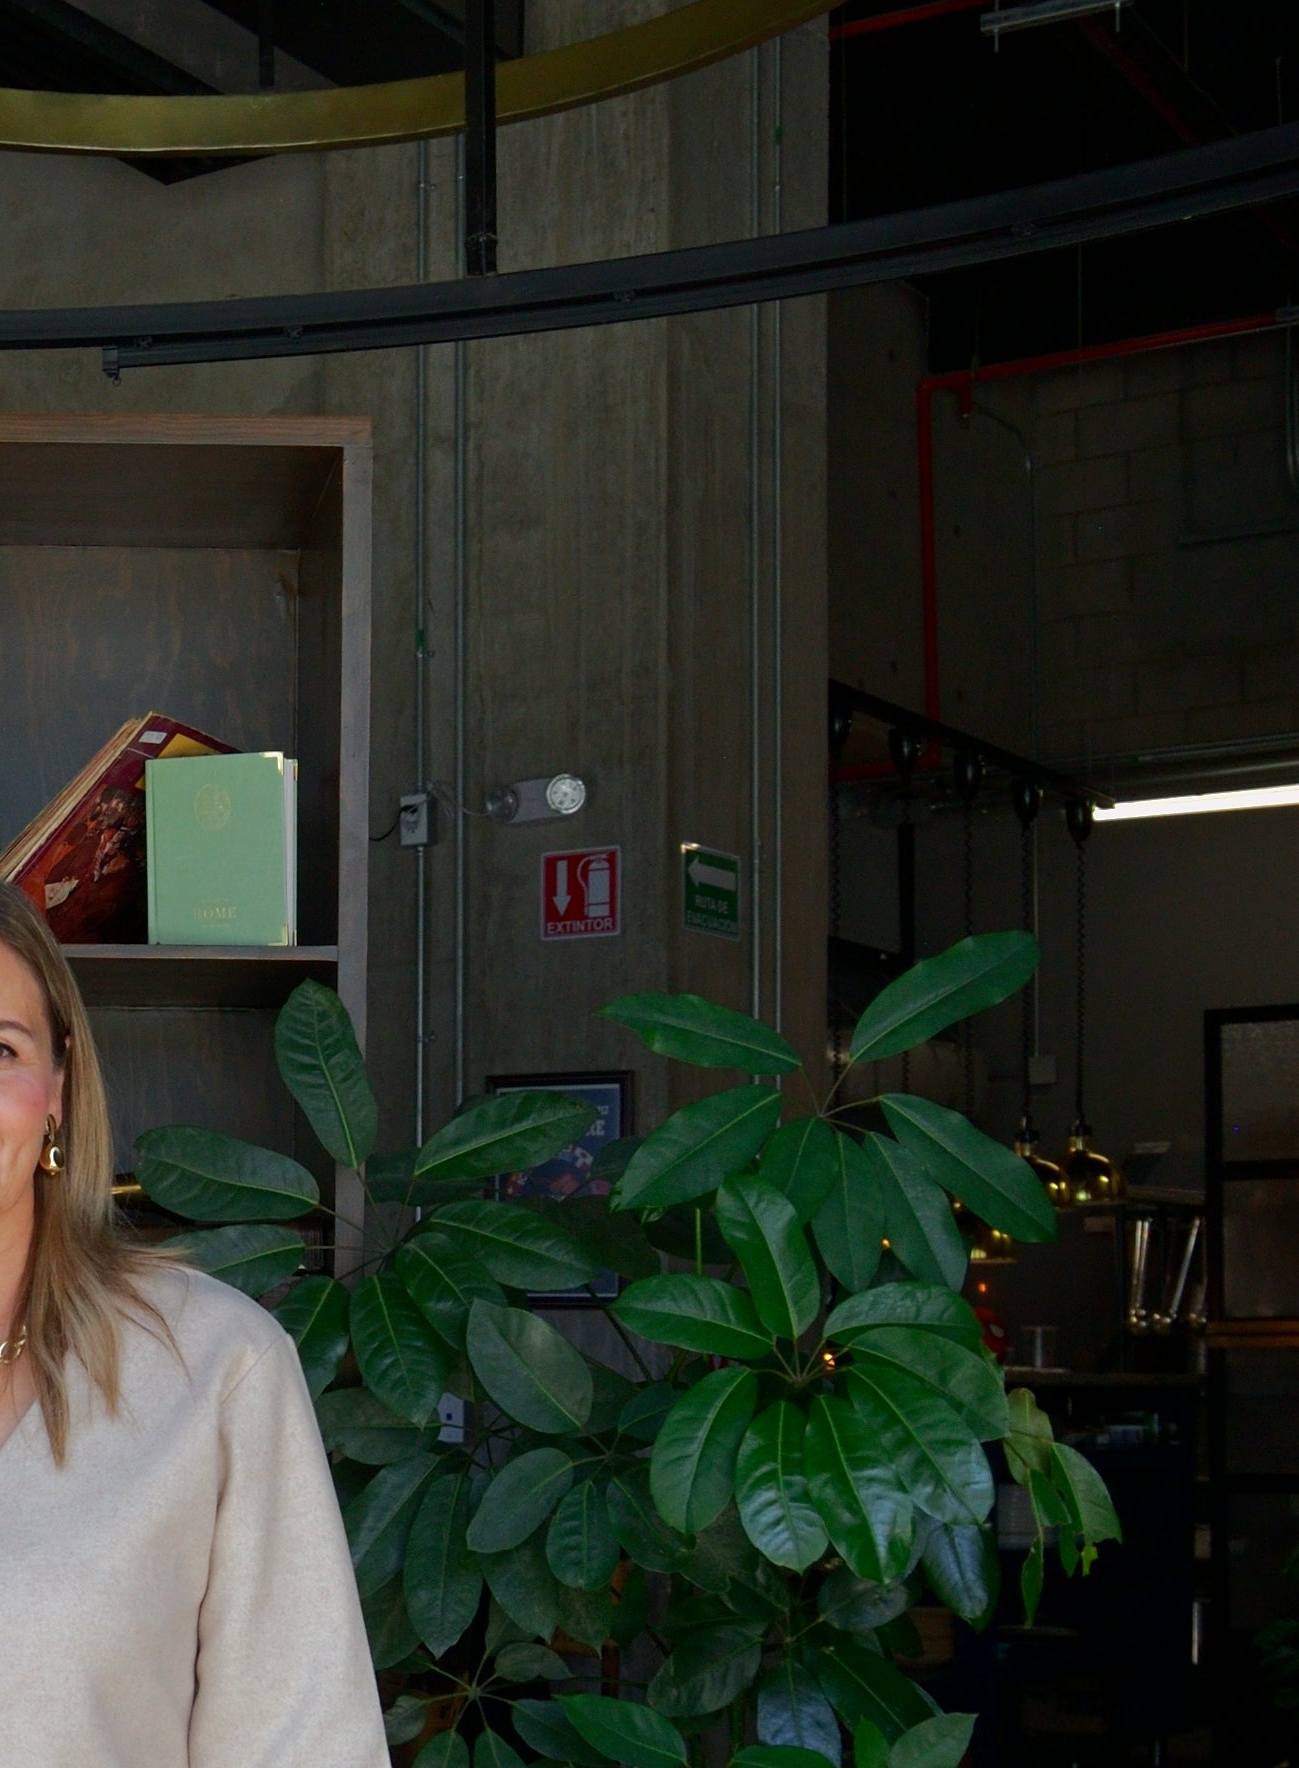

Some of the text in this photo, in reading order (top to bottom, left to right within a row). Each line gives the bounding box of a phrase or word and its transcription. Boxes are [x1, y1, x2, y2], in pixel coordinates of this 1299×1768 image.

[694, 894, 729, 914] RUTA DE
[192, 906, 237, 920] ROME
[547, 918, 614, 935] EXTINTOR
